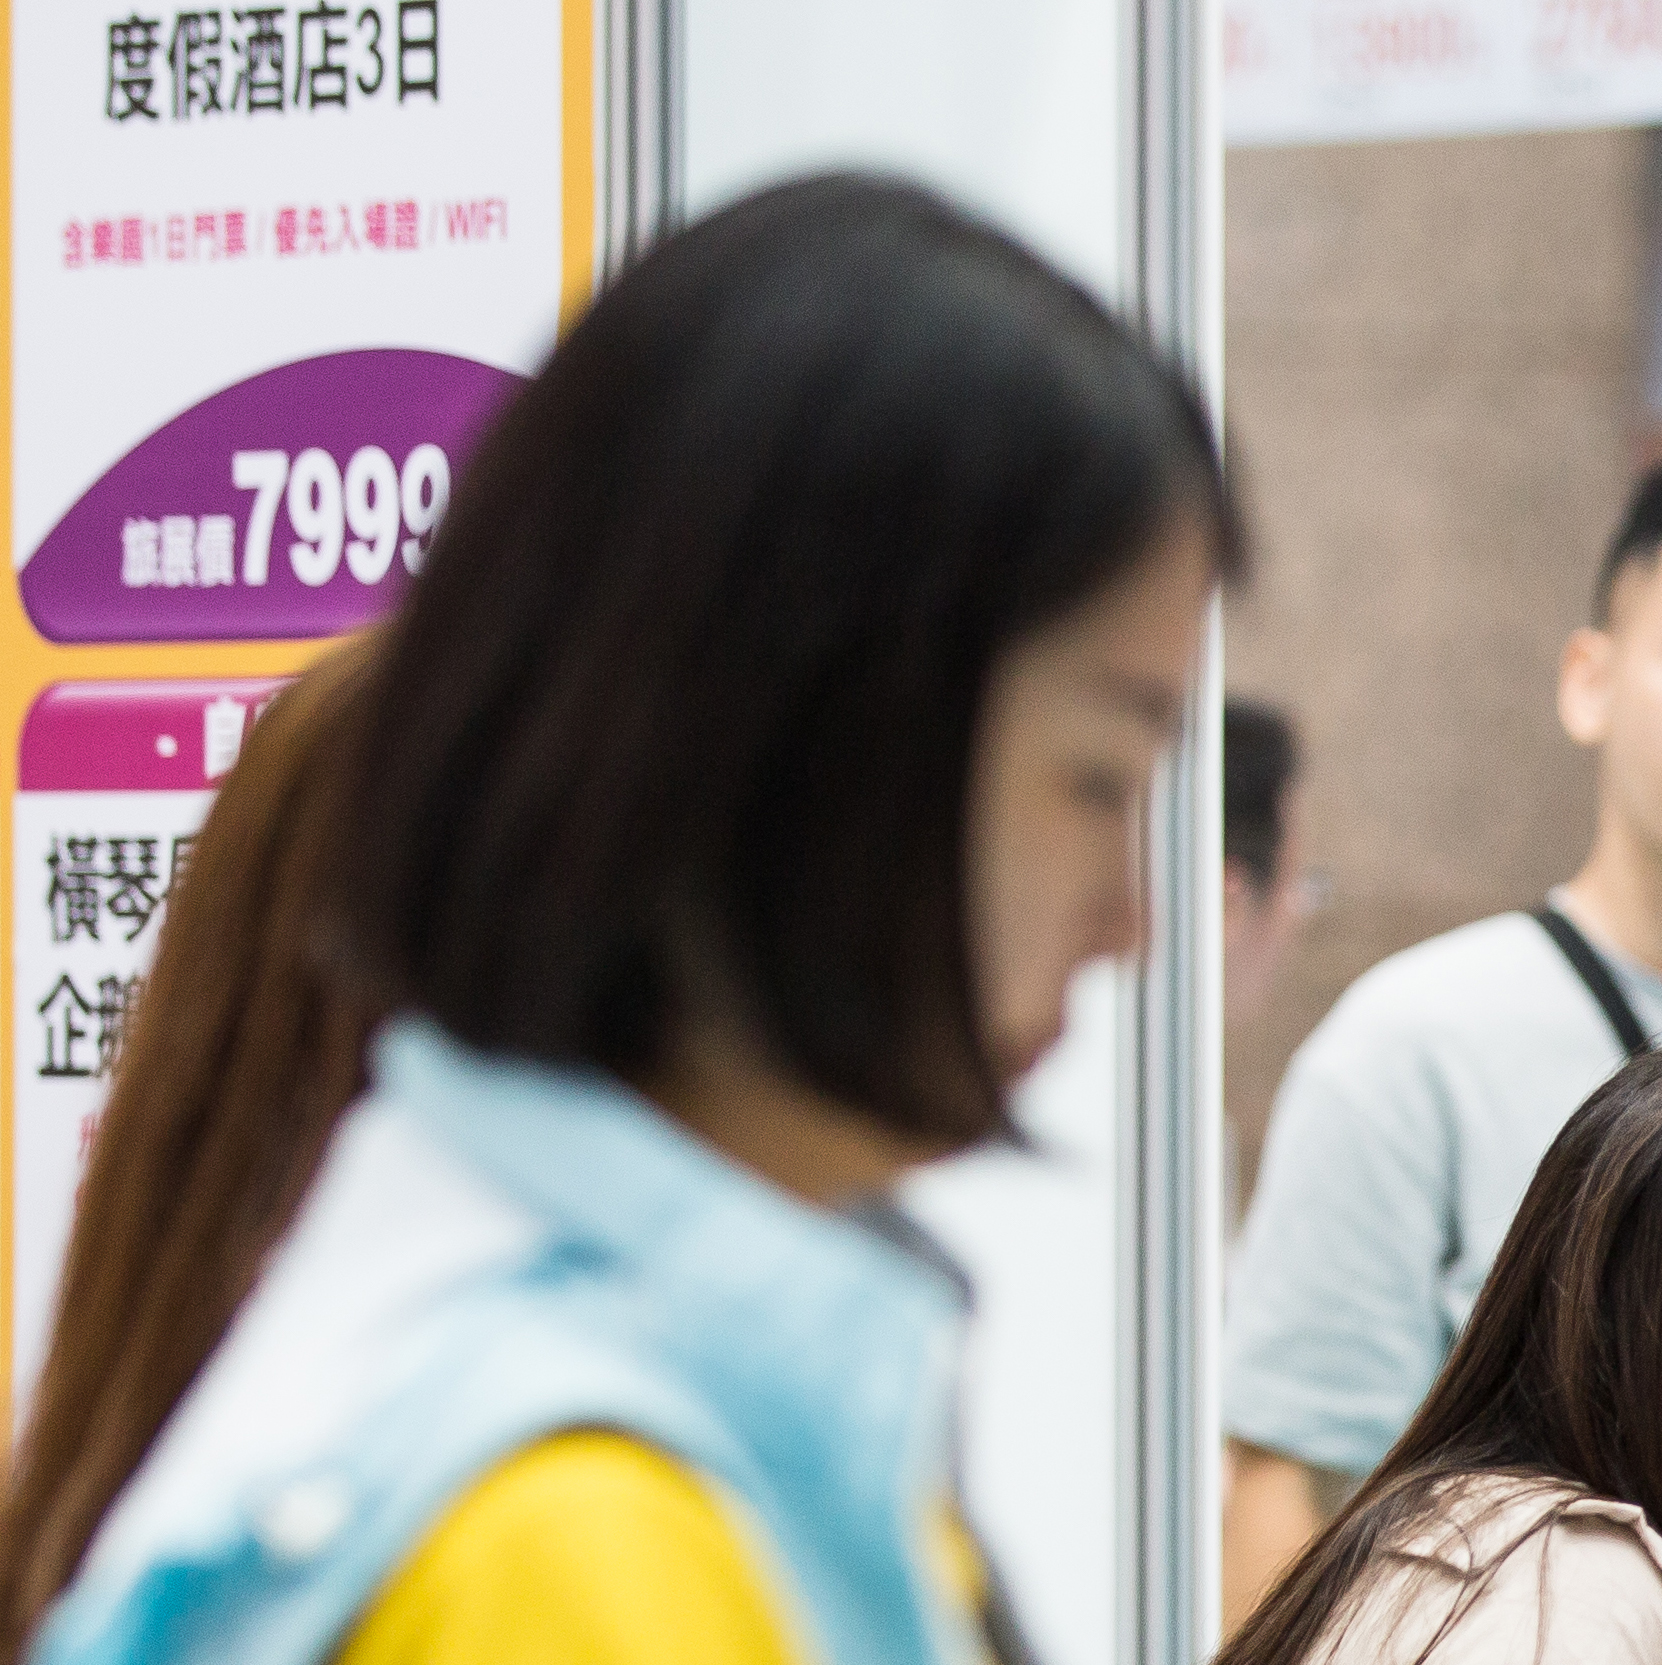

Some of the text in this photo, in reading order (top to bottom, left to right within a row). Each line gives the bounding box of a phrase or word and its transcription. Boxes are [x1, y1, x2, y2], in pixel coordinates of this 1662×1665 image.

[104, 0, 441, 122] 度假酒店3日
[231, 443, 452, 587] 7999
